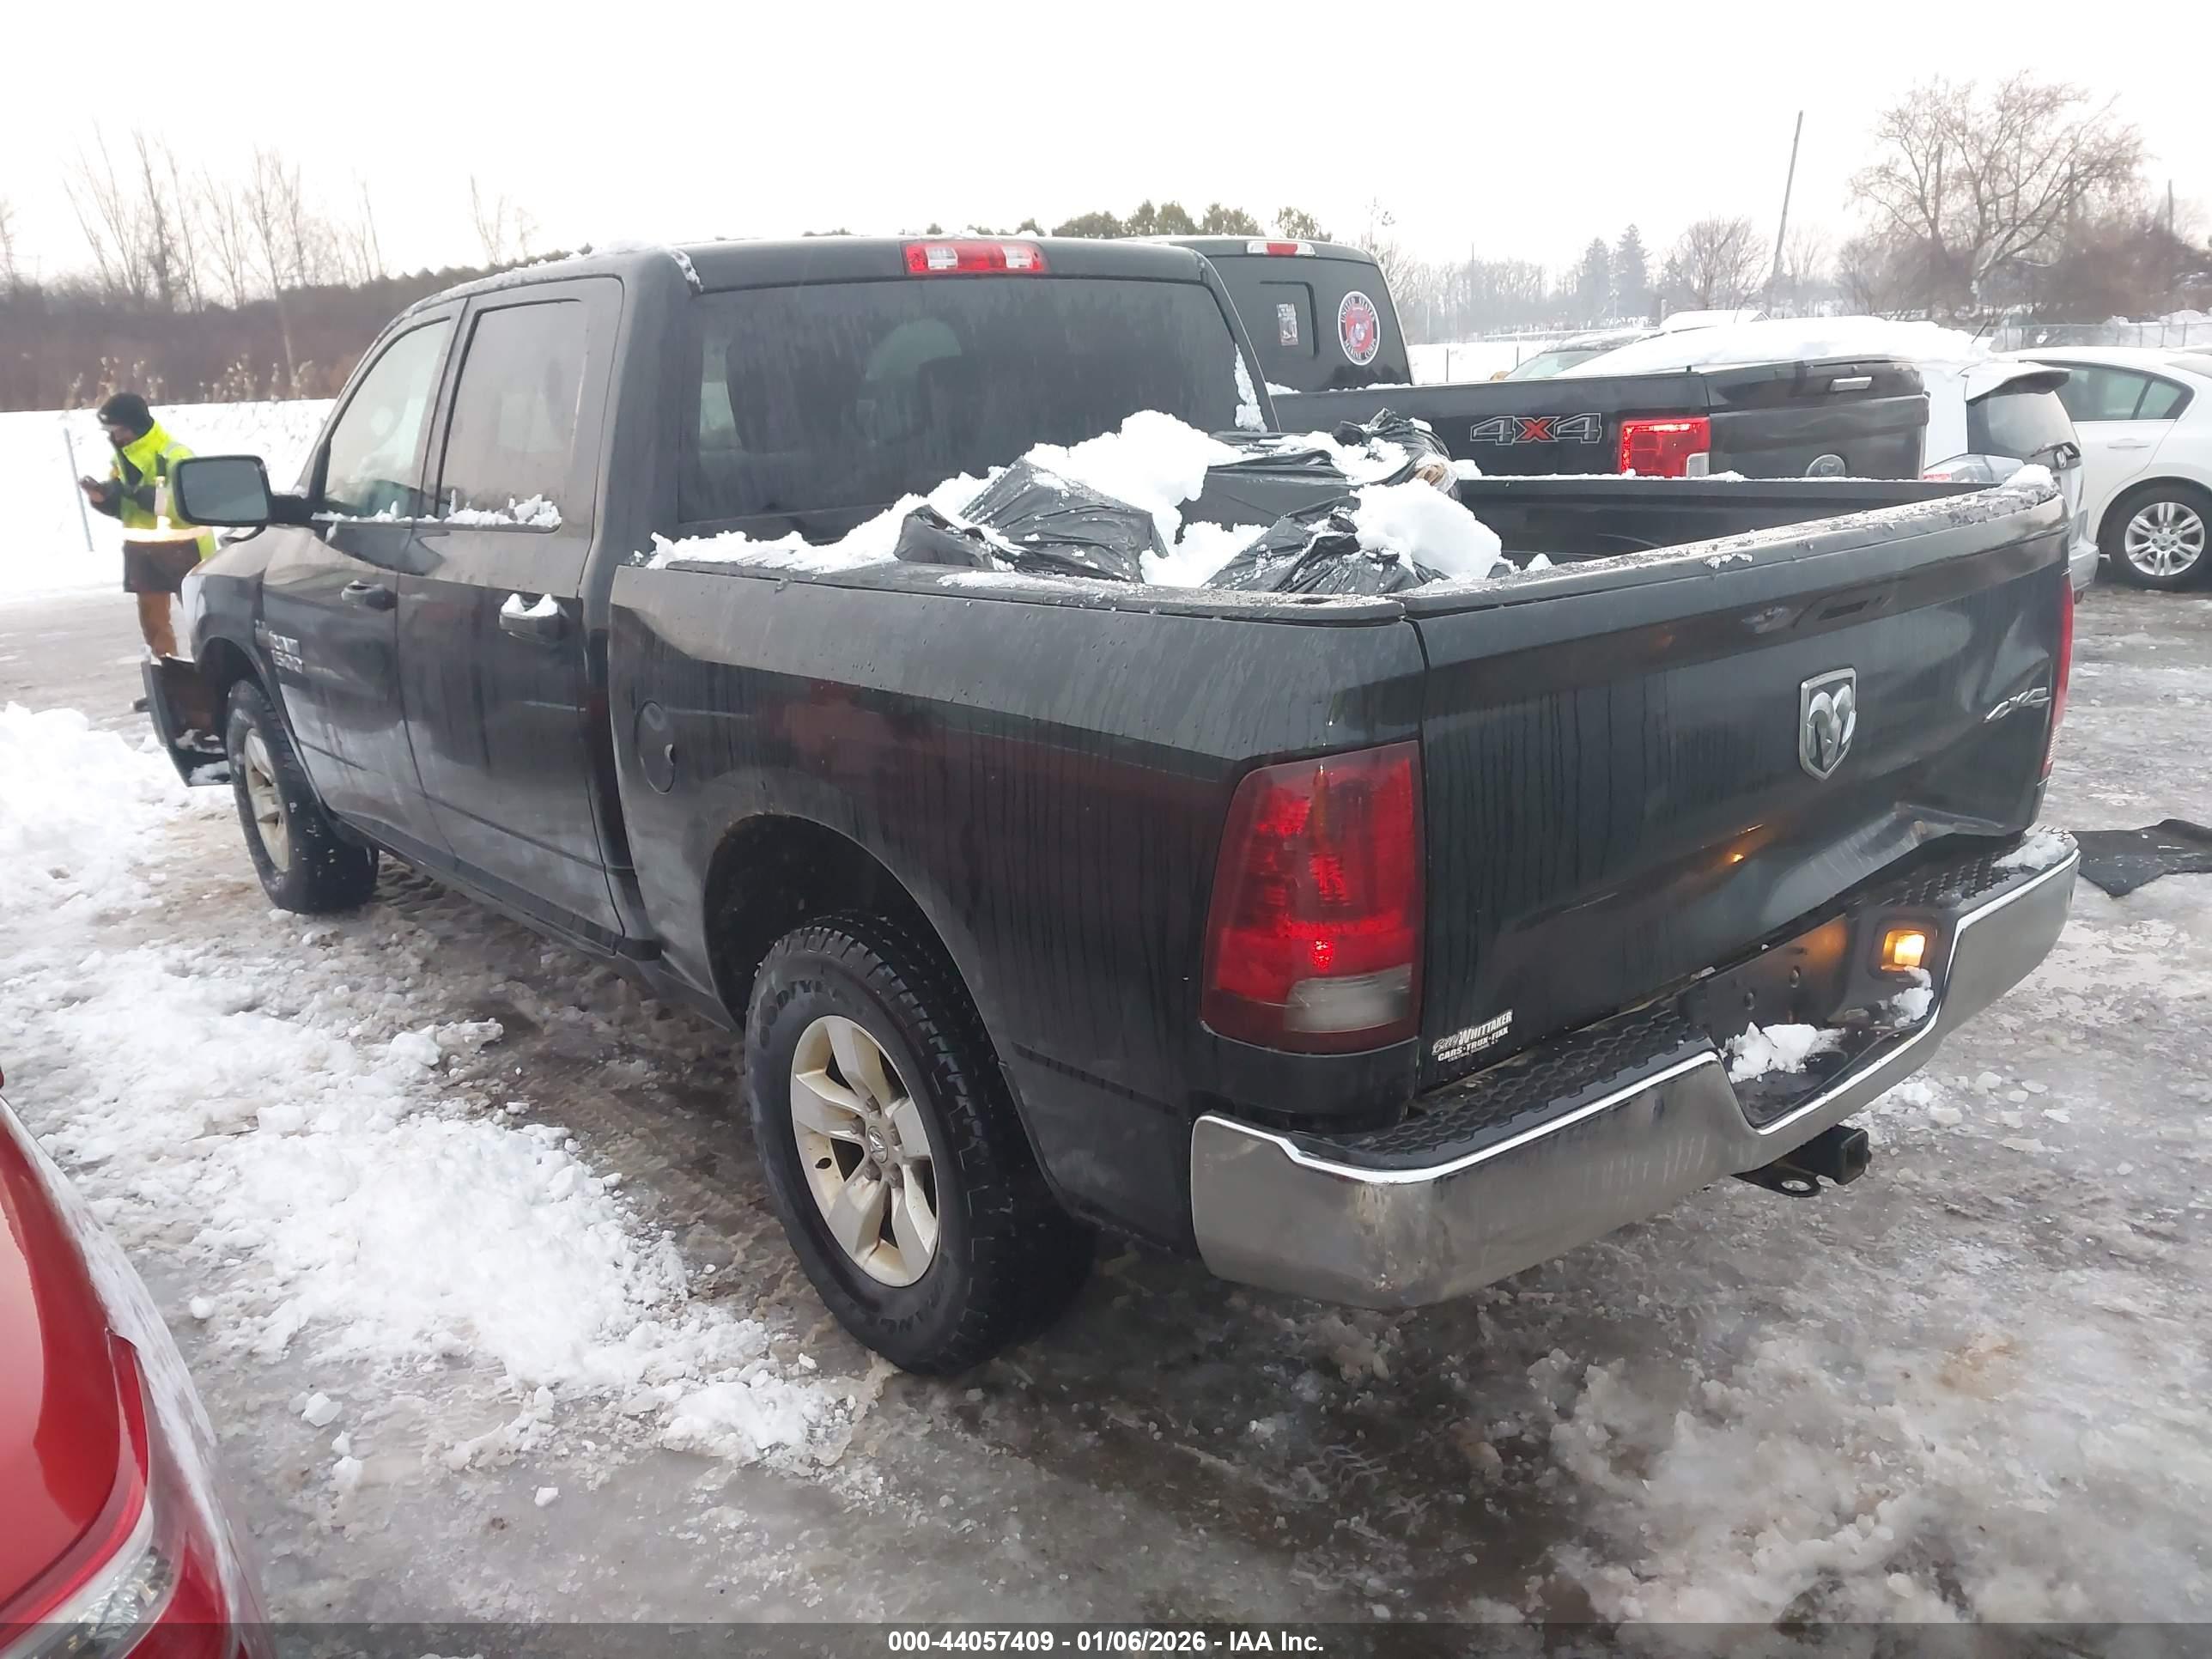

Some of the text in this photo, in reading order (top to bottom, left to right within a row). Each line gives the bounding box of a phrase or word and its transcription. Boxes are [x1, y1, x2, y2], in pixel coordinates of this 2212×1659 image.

[1340, 296, 1375, 323] UNITED STATES
[1345, 338, 1362, 360] MARINE
